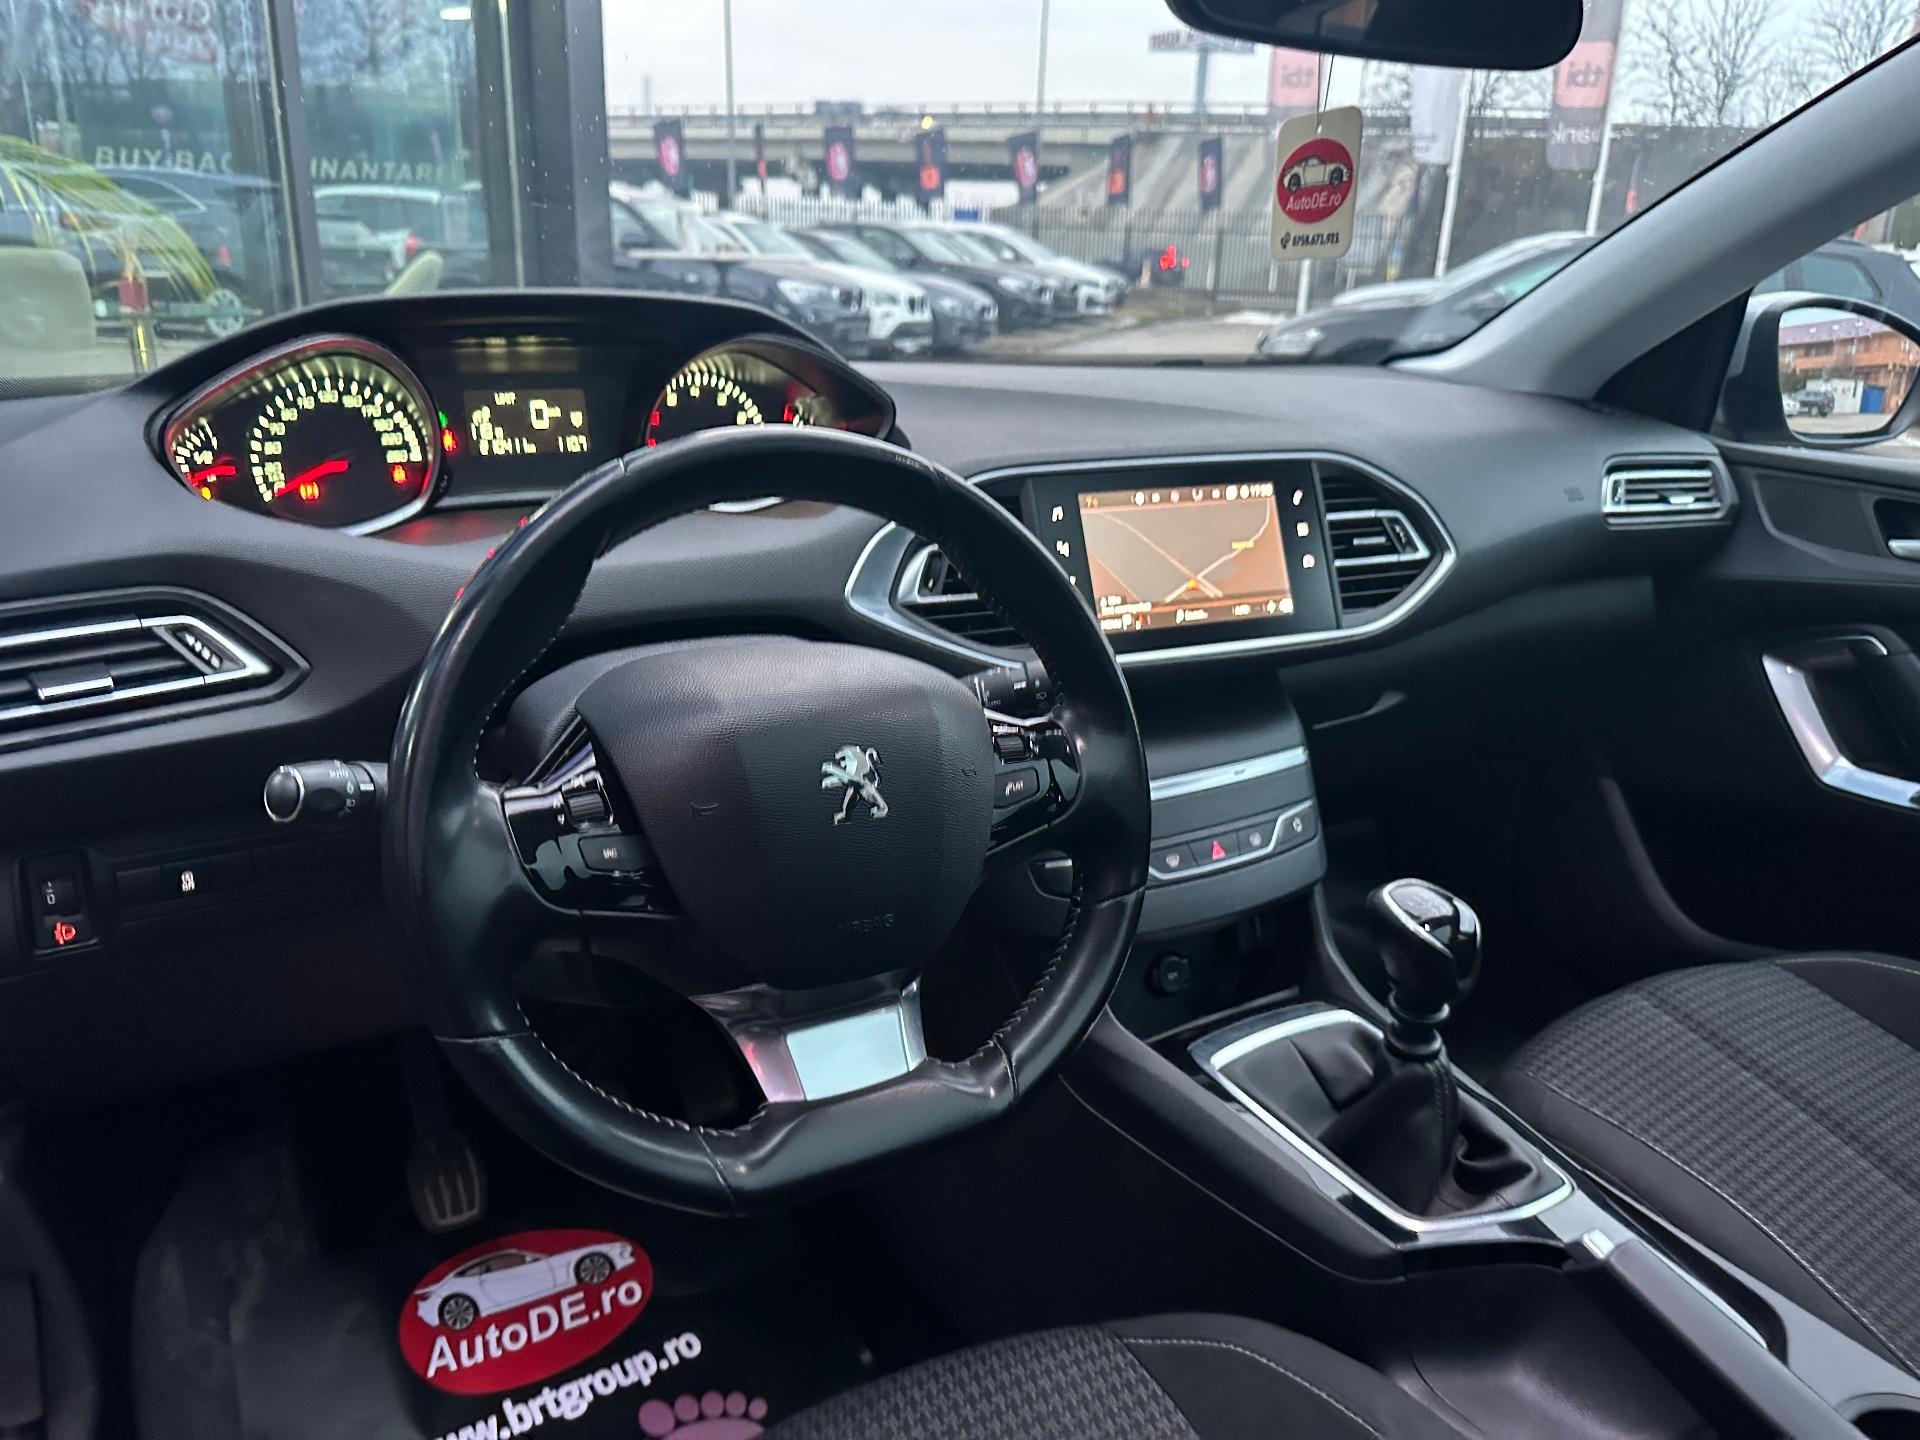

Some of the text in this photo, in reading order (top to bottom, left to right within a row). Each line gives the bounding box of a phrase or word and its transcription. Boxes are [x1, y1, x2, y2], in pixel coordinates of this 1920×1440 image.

[95, 146, 160, 170] BUY
[1286, 191, 1342, 211] AutoDE.ro
[426, 1280, 643, 1378] AutoDE.ro
[434, 1331, 703, 1440] w.brtgroup.ro
